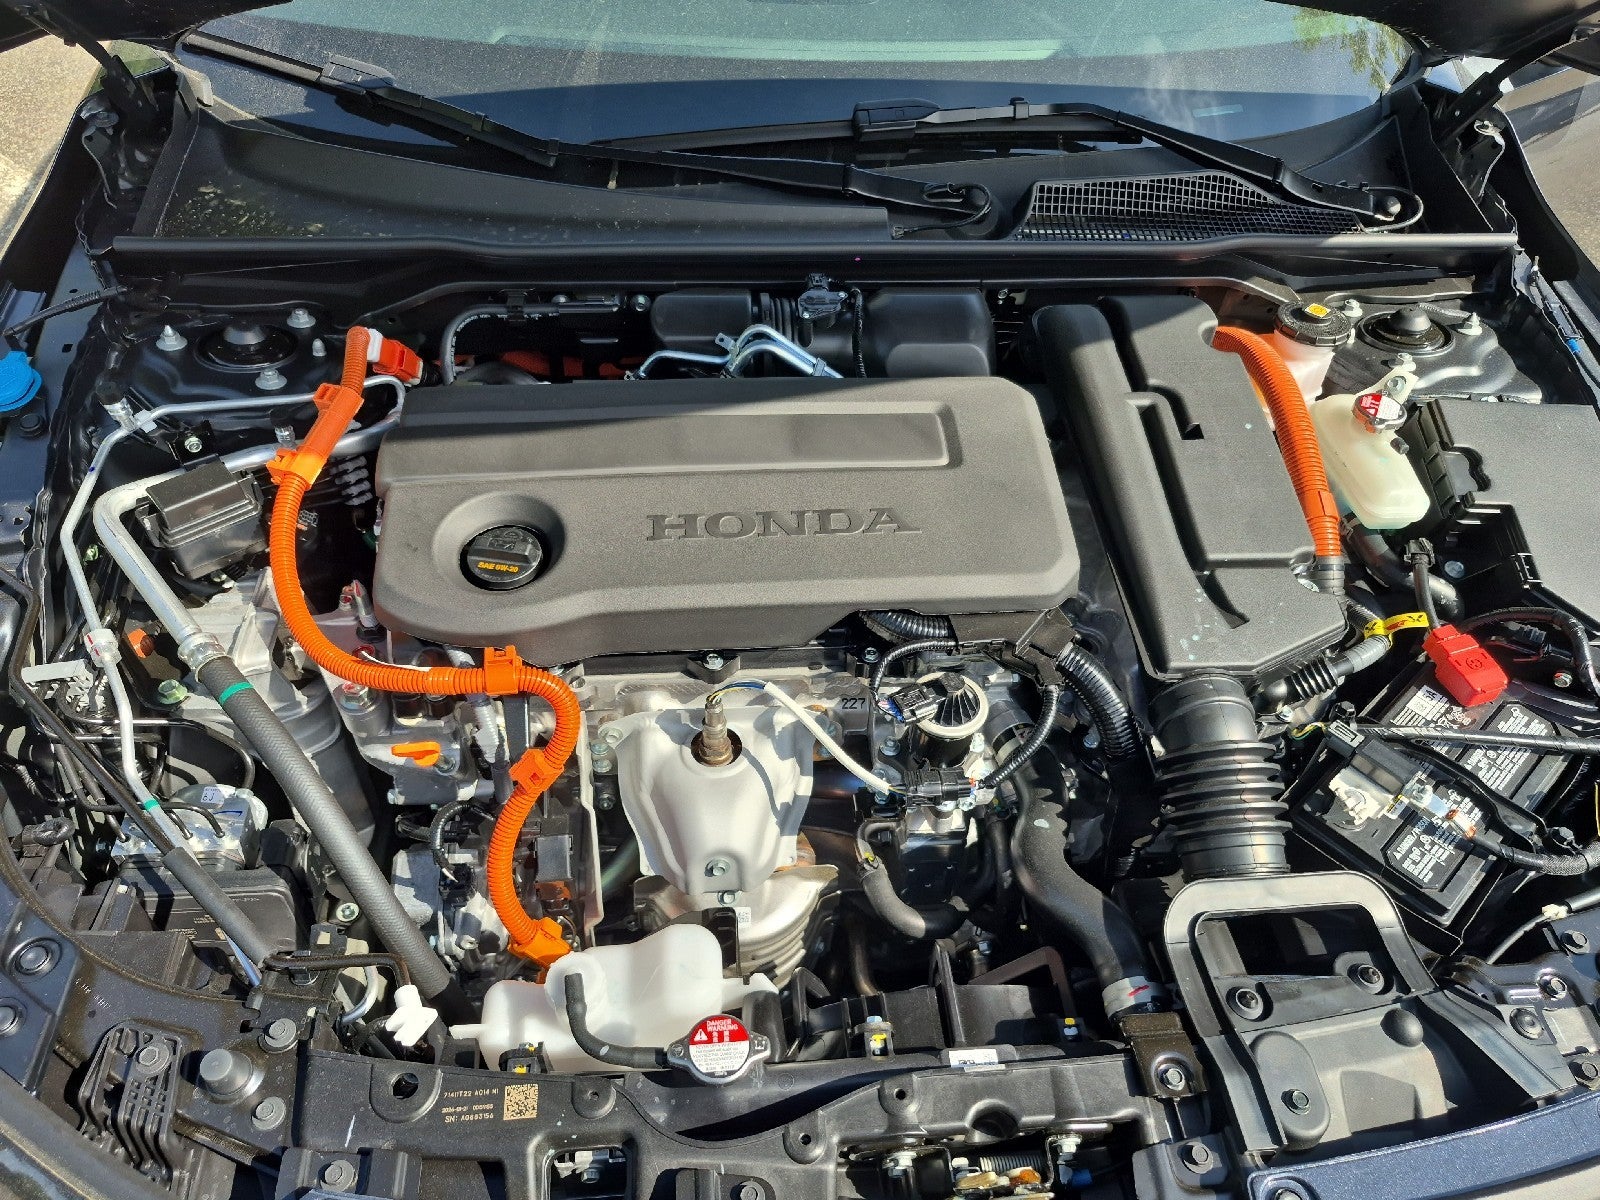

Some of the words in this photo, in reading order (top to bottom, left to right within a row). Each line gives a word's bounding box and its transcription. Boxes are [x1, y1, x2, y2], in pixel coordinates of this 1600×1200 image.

[646, 507, 923, 542] HONDA
[477, 561, 495, 570] SAE
[841, 697, 866, 710] 227
[707, 1018, 731, 1026] DANGER
